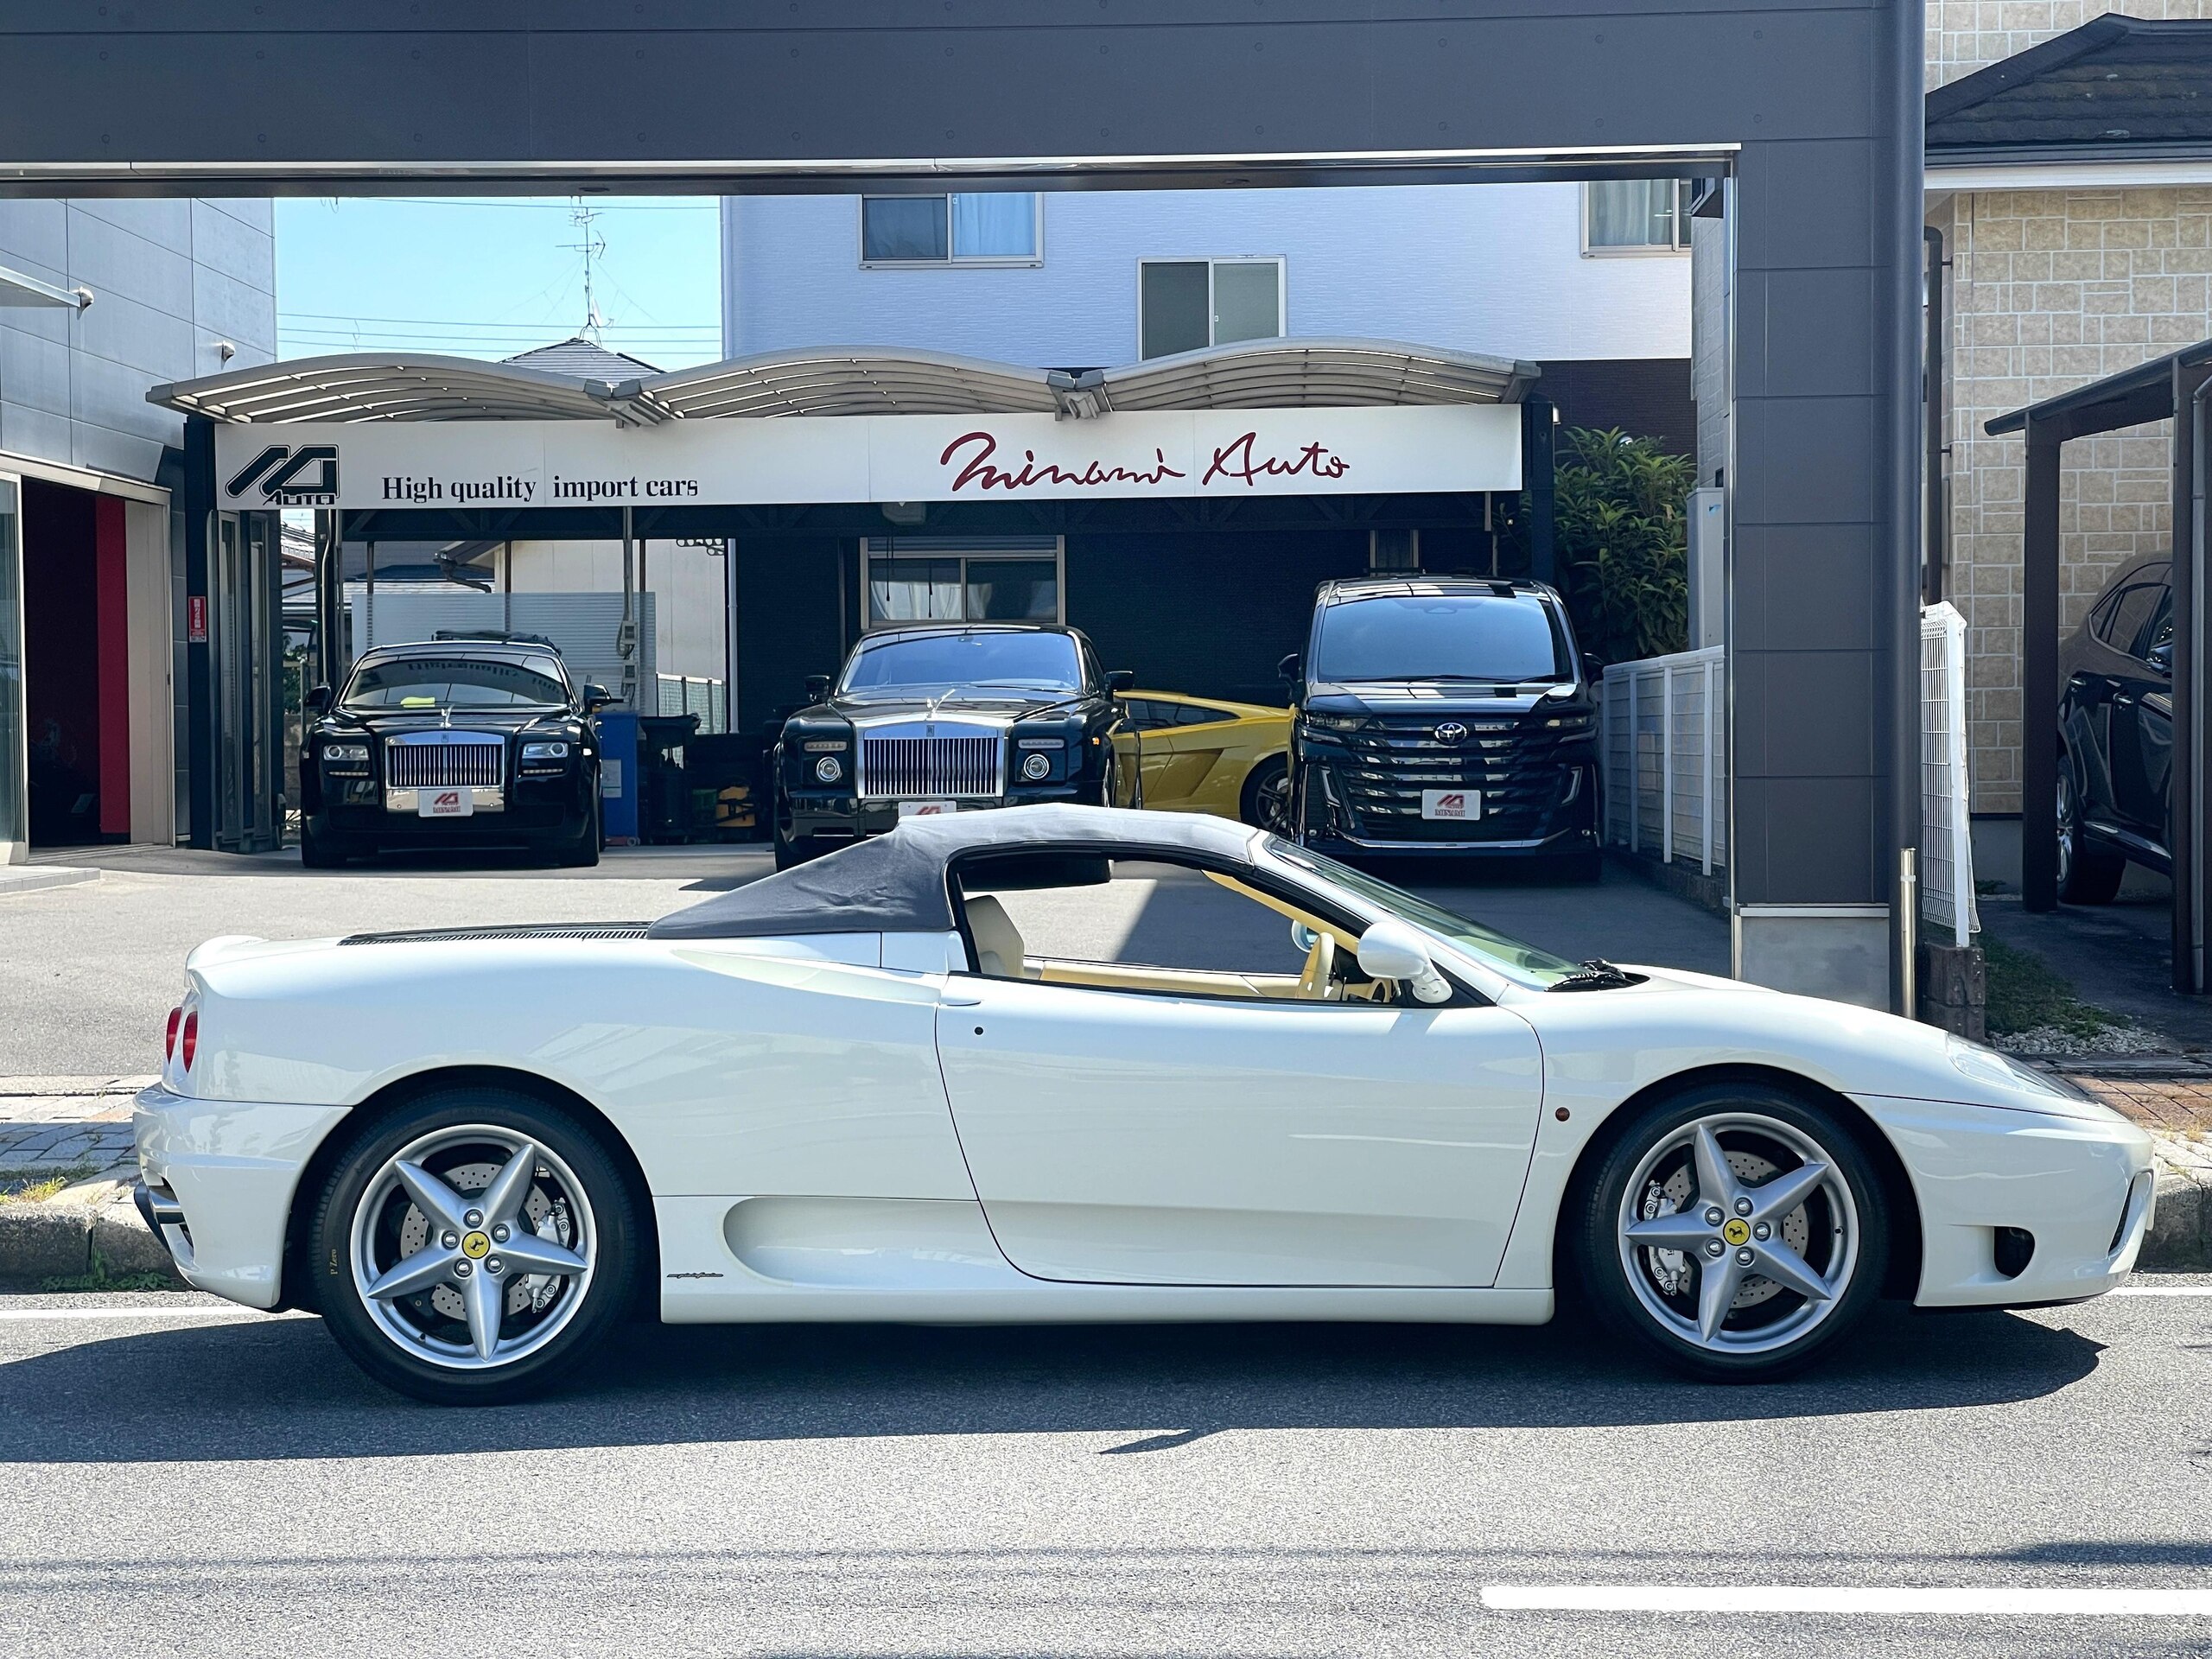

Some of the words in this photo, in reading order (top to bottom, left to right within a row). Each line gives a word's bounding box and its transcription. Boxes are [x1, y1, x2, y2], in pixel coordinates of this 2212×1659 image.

[940, 432, 1185, 491] Minami
[1203, 432, 1350, 486] Auto
[263, 490, 334, 505] AUTO
[382, 477, 442, 503] High
[450, 476, 537, 502] quality
[553, 475, 639, 501] import
[646, 479, 698, 498] cars
